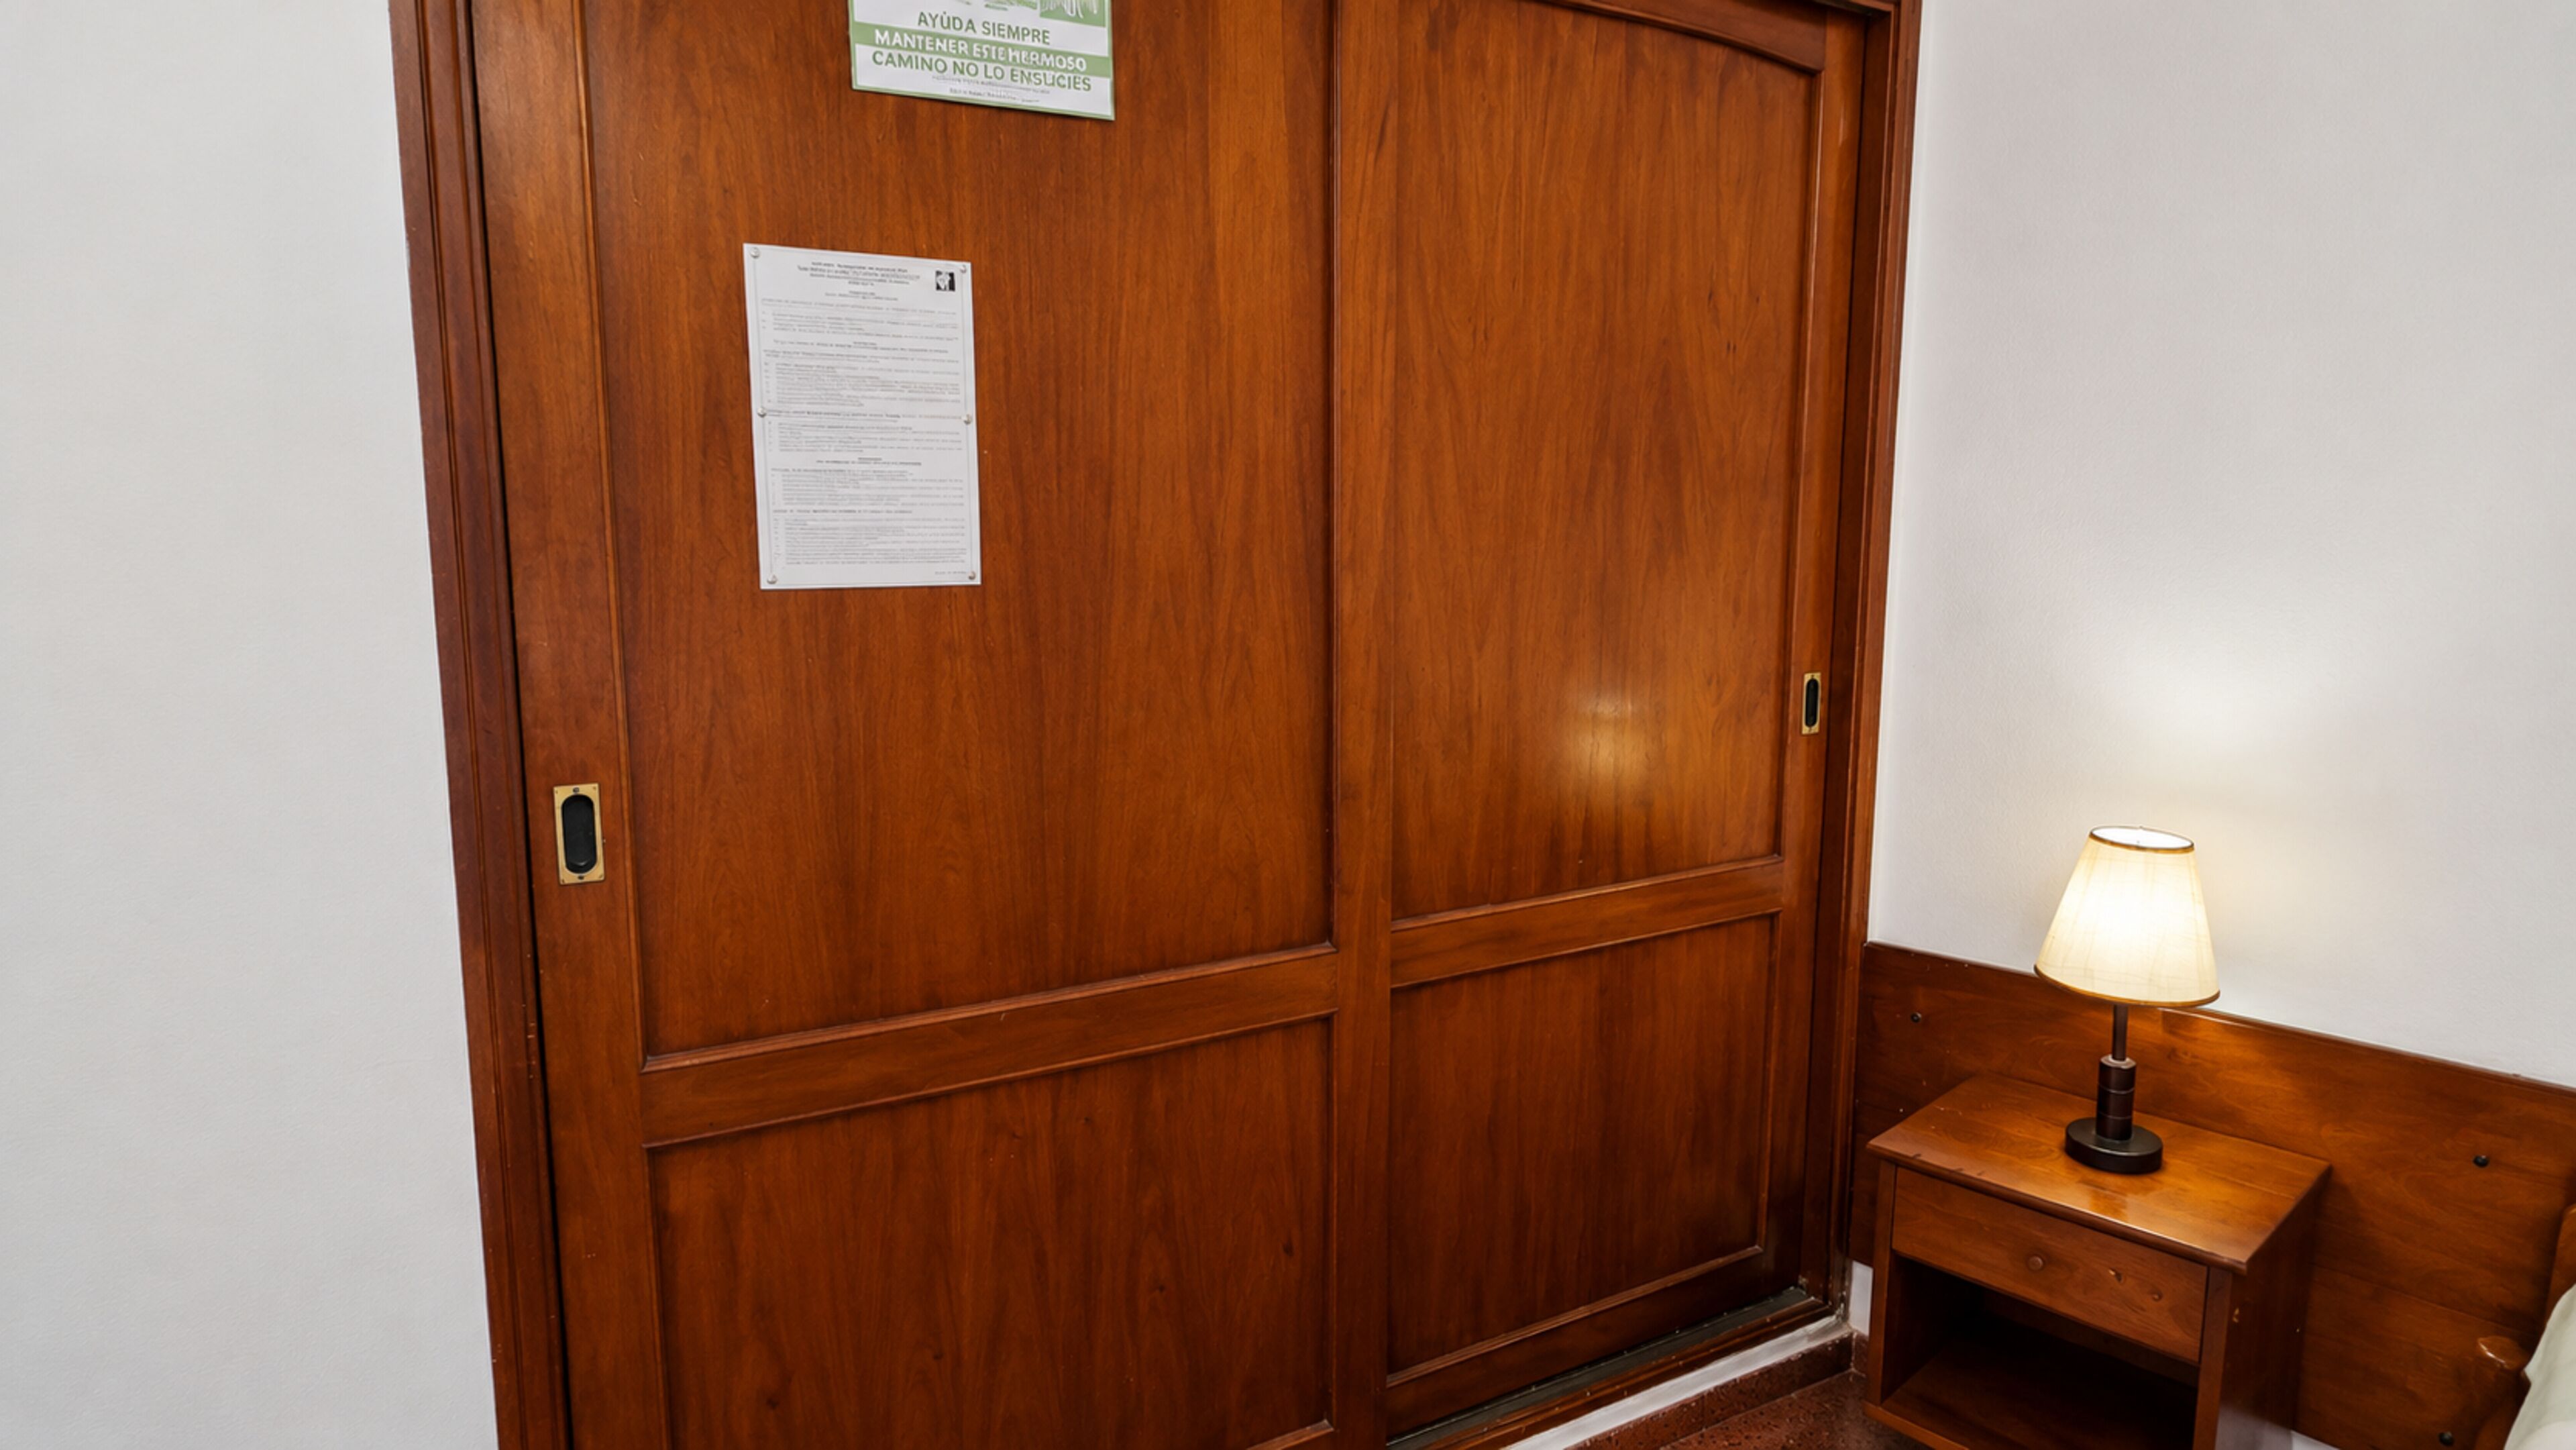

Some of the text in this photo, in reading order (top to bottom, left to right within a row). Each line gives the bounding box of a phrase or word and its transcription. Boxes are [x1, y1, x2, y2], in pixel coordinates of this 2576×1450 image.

[874, 29, 969, 55] MANTENER
[1008, 48, 1087, 72] HERMOSO
[982, 21, 1051, 45] SIEMPRE
[872, 50, 948, 74] CAMINO
[953, 61, 979, 78] NO
[983, 64, 1005, 81] LO
[1010, 68, 1092, 92] ENSUCIES
